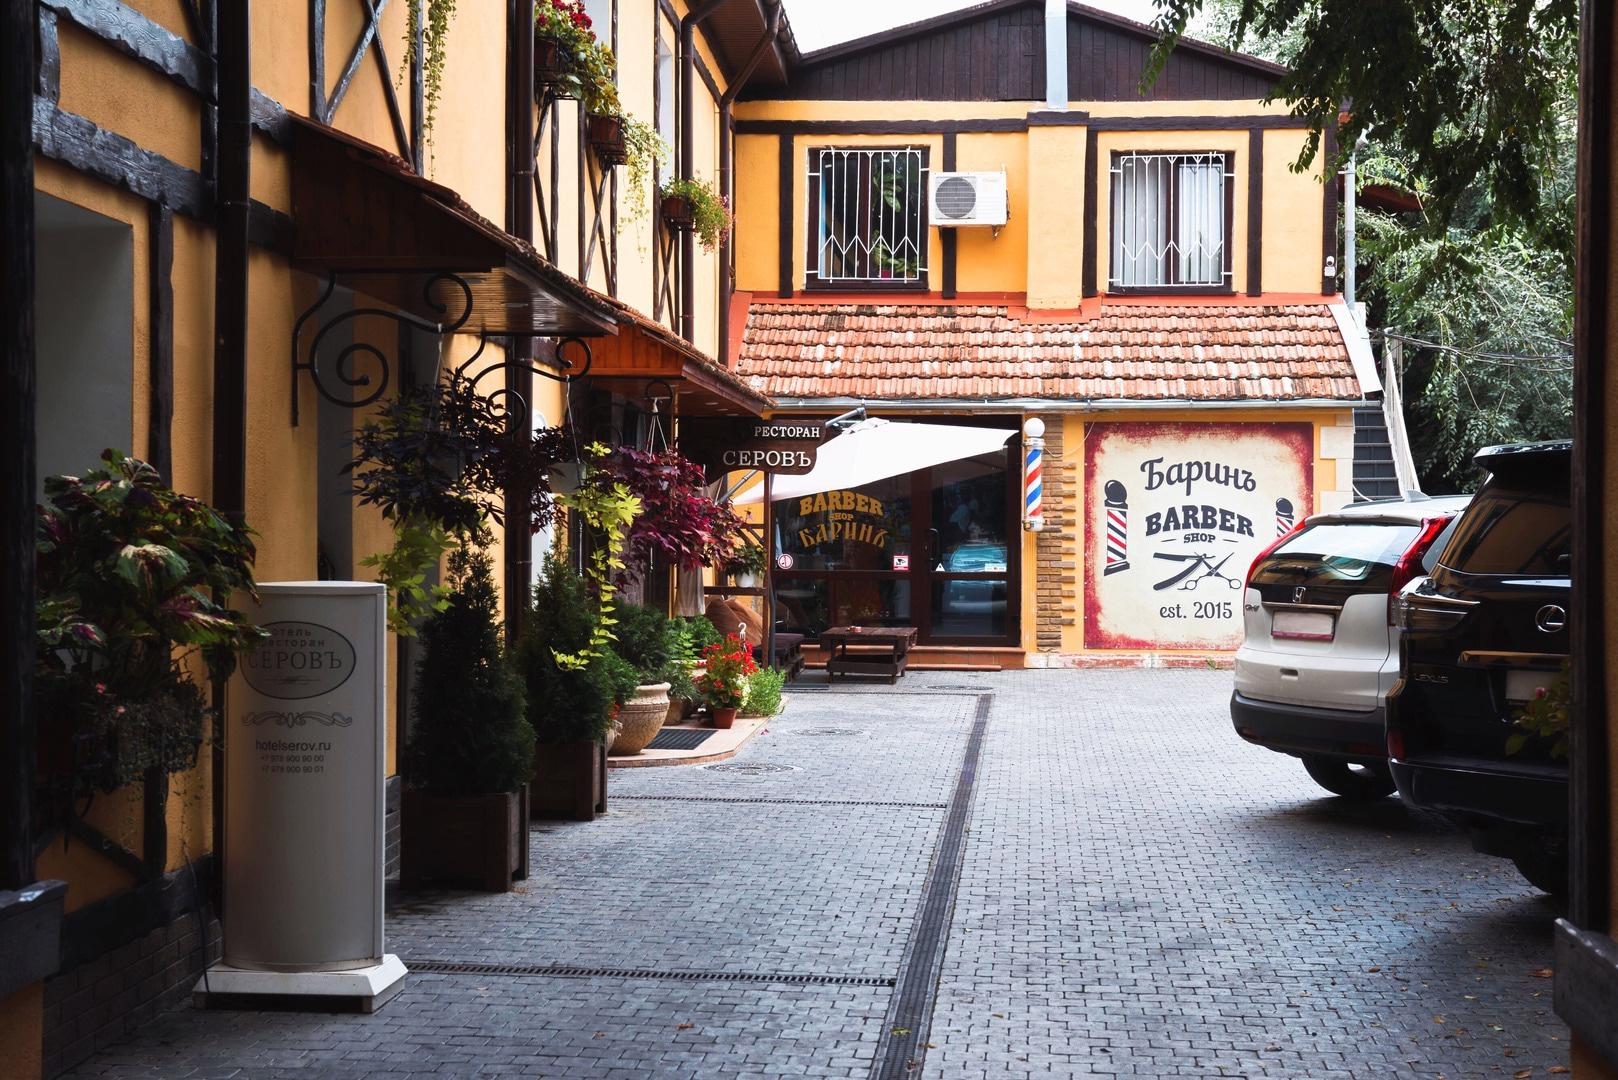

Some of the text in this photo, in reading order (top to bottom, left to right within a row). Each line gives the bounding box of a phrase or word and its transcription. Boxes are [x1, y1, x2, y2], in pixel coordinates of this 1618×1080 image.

[754, 426, 821, 438] РЕСТОРАН
[722, 450, 812, 467] СЕРОВЪ
[1140, 457, 1257, 496] Баринъ
[800, 490, 884, 517] BARBER
[829, 512, 854, 521] SHOP
[1145, 505, 1255, 538] BARBER
[1183, 532, 1216, 544] SHOP
[1159, 601, 1233, 619] est. 2015
[272, 628, 312, 637] отель
[248, 651, 342, 670] СЕРОВЪ
[255, 739, 331, 751] hotelserov.ru
